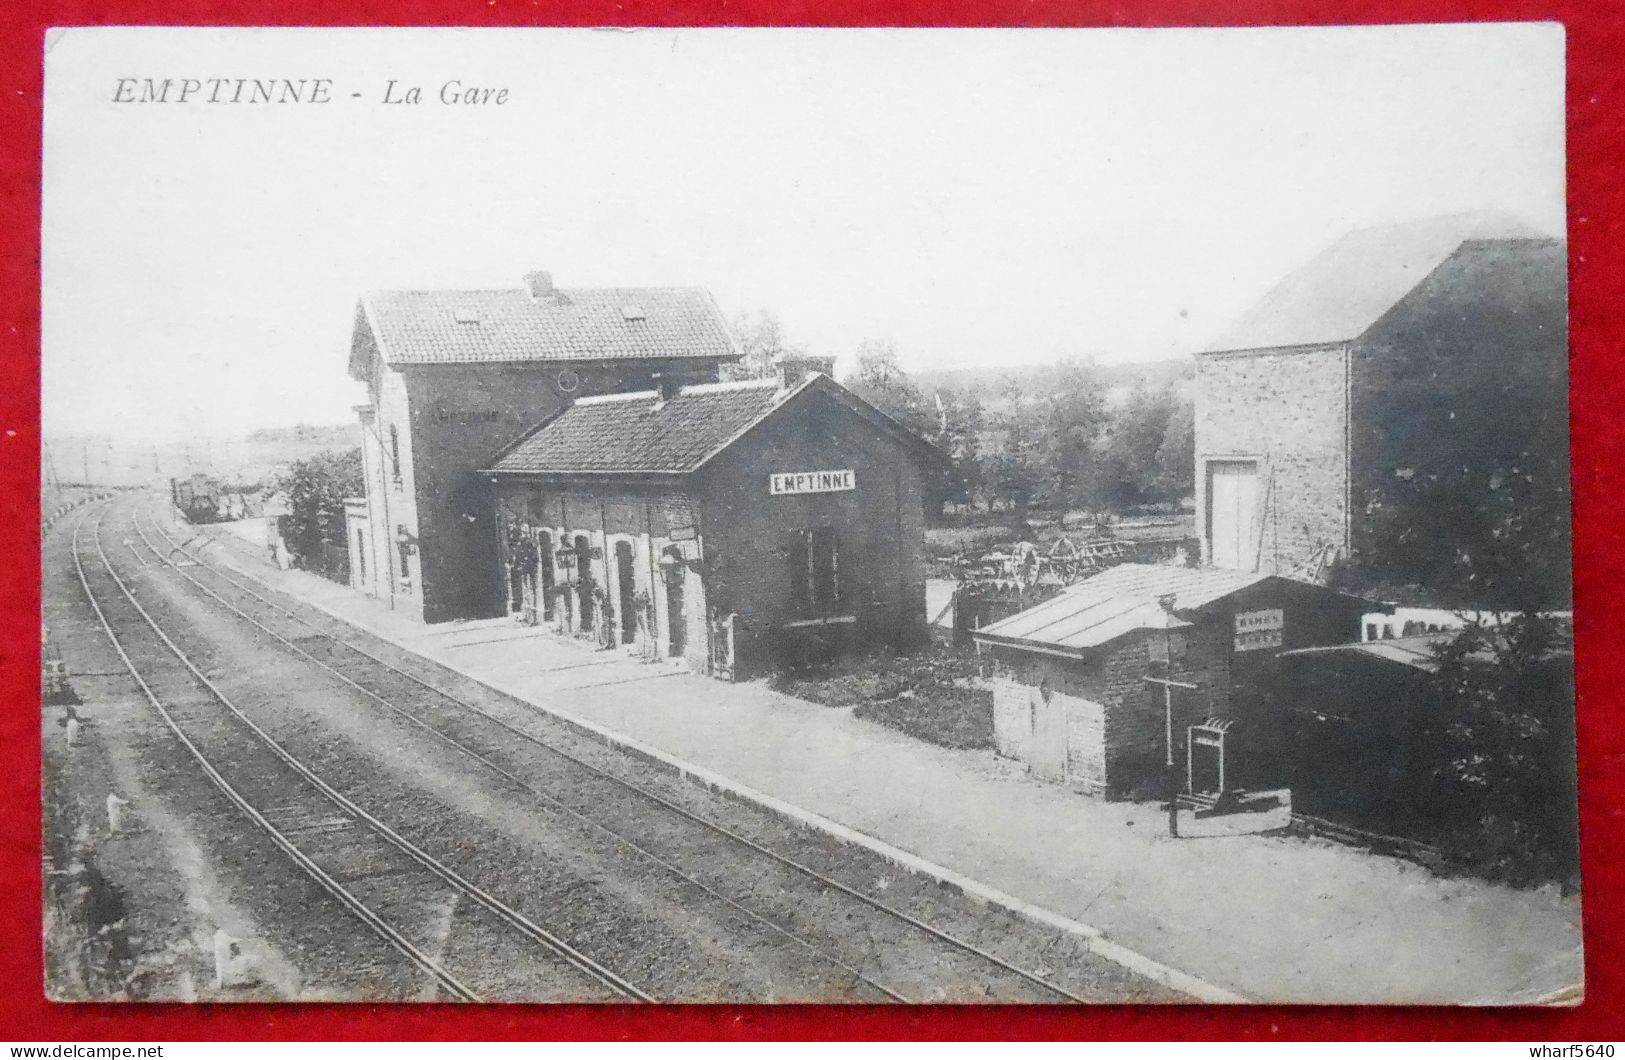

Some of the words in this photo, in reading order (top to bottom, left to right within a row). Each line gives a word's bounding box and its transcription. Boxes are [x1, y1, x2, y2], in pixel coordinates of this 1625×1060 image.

[112, 78, 333, 104] EMPTINNE
[381, 80, 422, 105] La
[439, 80, 510, 106] Gare
[774, 472, 850, 491] EMPTINNE
